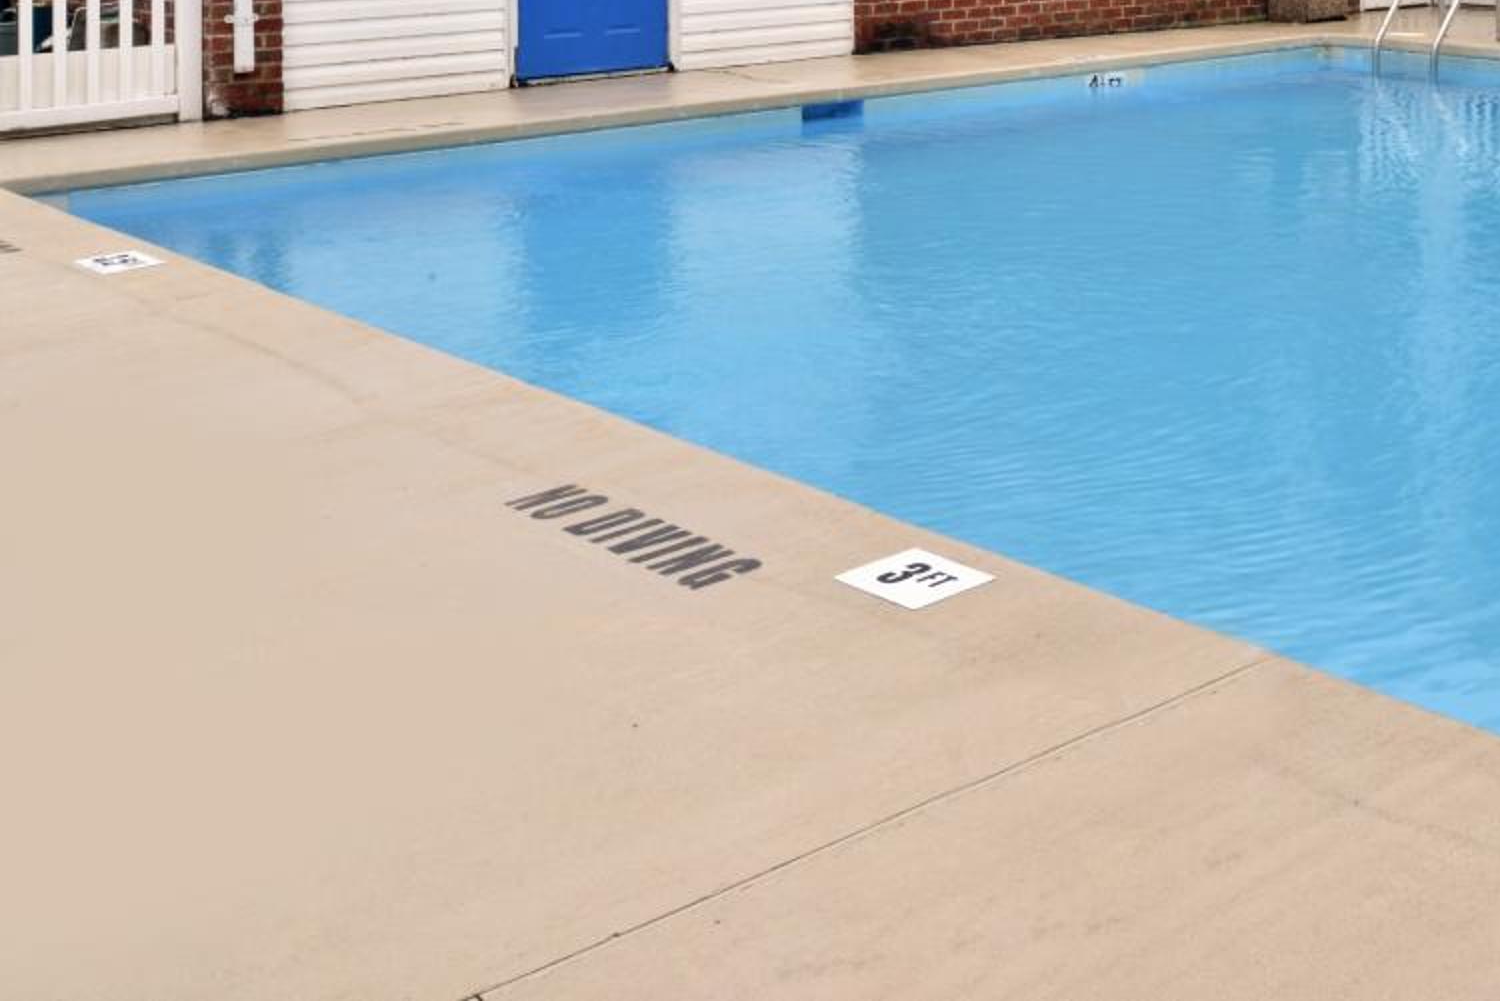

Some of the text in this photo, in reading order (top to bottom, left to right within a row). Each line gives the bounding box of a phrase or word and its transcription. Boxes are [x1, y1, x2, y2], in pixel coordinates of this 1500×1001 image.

[503, 484, 763, 591] NO DIVING
[876, 562, 959, 587] 3 FT
